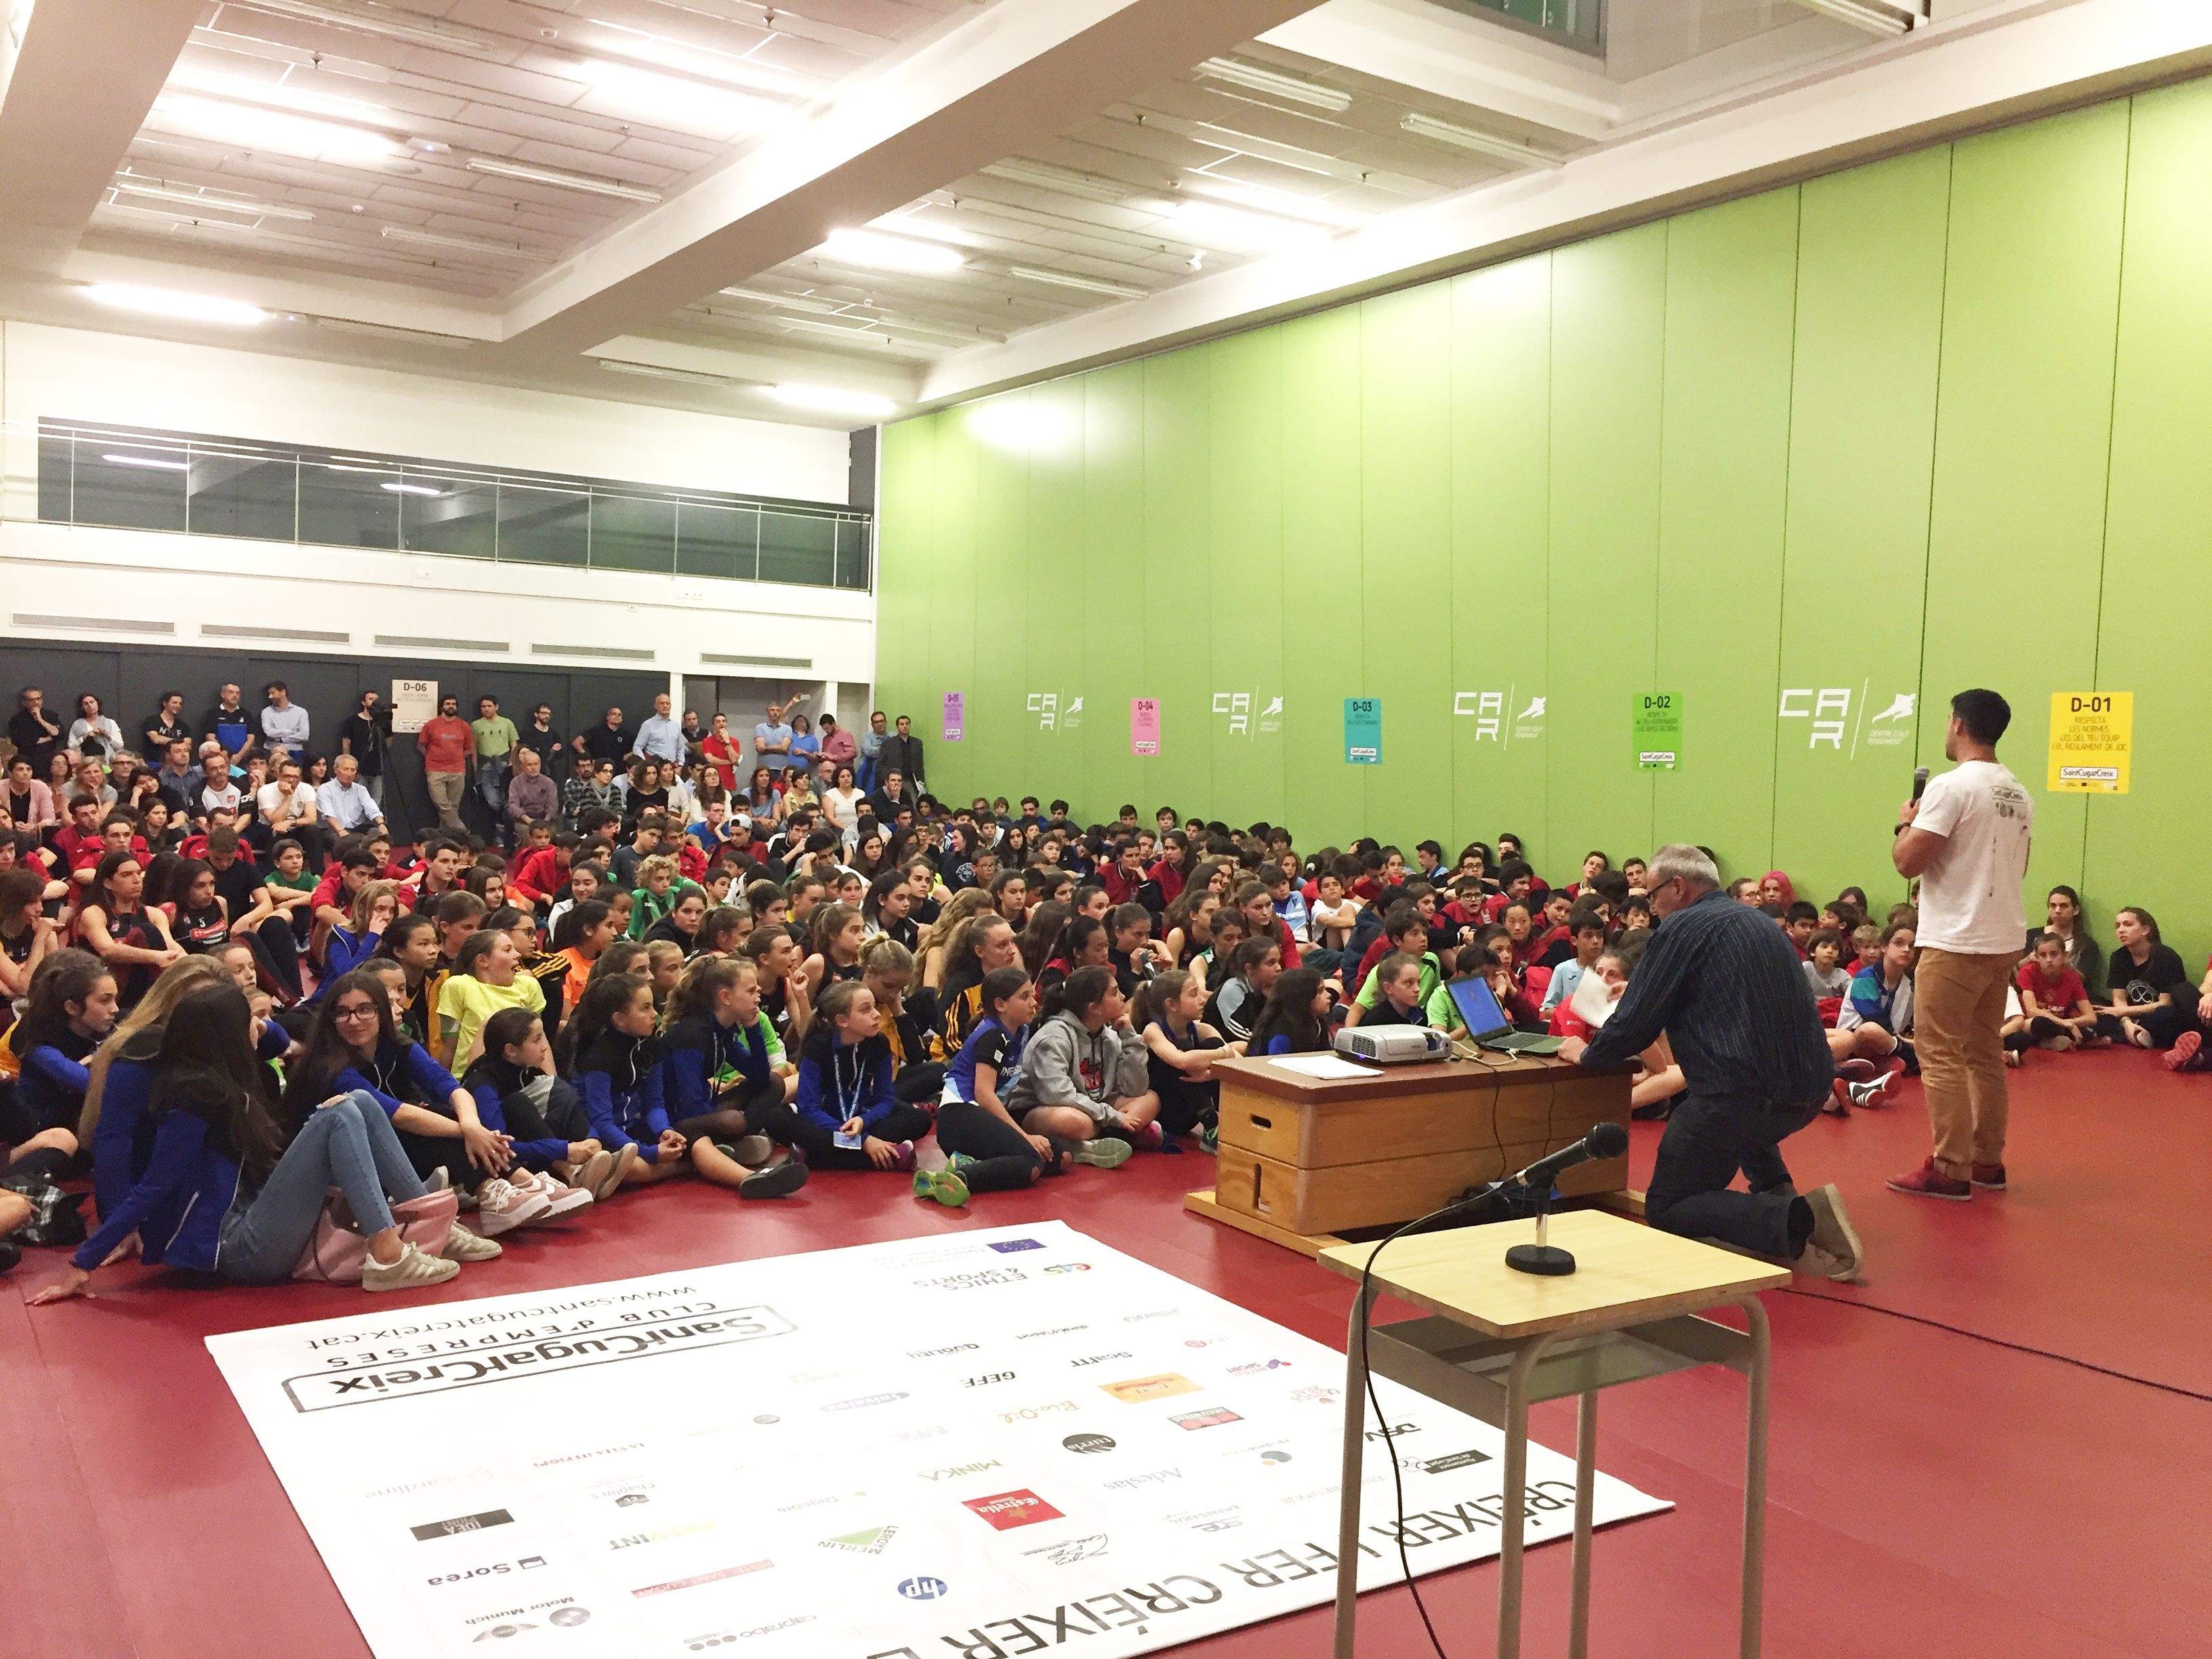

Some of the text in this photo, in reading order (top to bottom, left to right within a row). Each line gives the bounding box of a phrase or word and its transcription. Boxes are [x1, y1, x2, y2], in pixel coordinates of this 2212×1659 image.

[404, 682, 427, 691] D-06
[1139, 701, 1153, 710] D-04
[1353, 701, 1372, 712] D-03
[1645, 696, 1671, 708] D-02
[2071, 697, 2111, 712] D-01
[2063, 769, 2114, 777] SantCugatCreix
[912, 1269, 1001, 1288] SPORTS
[943, 1273, 1028, 1290] ETHICS
[304, 1286, 697, 1351] www.santcugatcreix.cat
[325, 1302, 717, 1368] CLUB d'EMPRESES
[328, 1316, 766, 1395] SantCugatCreix
[964, 1371, 1016, 1388] GEFF
[1103, 1467, 1183, 1490] Adeslas
[444, 1521, 482, 1535] IDEA
[877, 1525, 899, 1549] LEROY
[817, 1540, 882, 1555] MERLIN
[427, 1563, 511, 1586] Sorea
[1219, 1542, 1339, 1589] FER
[465, 1597, 574, 1626] Motor Munich
[939, 1575, 1223, 1659] CRÉIXER
[739, 1614, 817, 1639] caprabo
